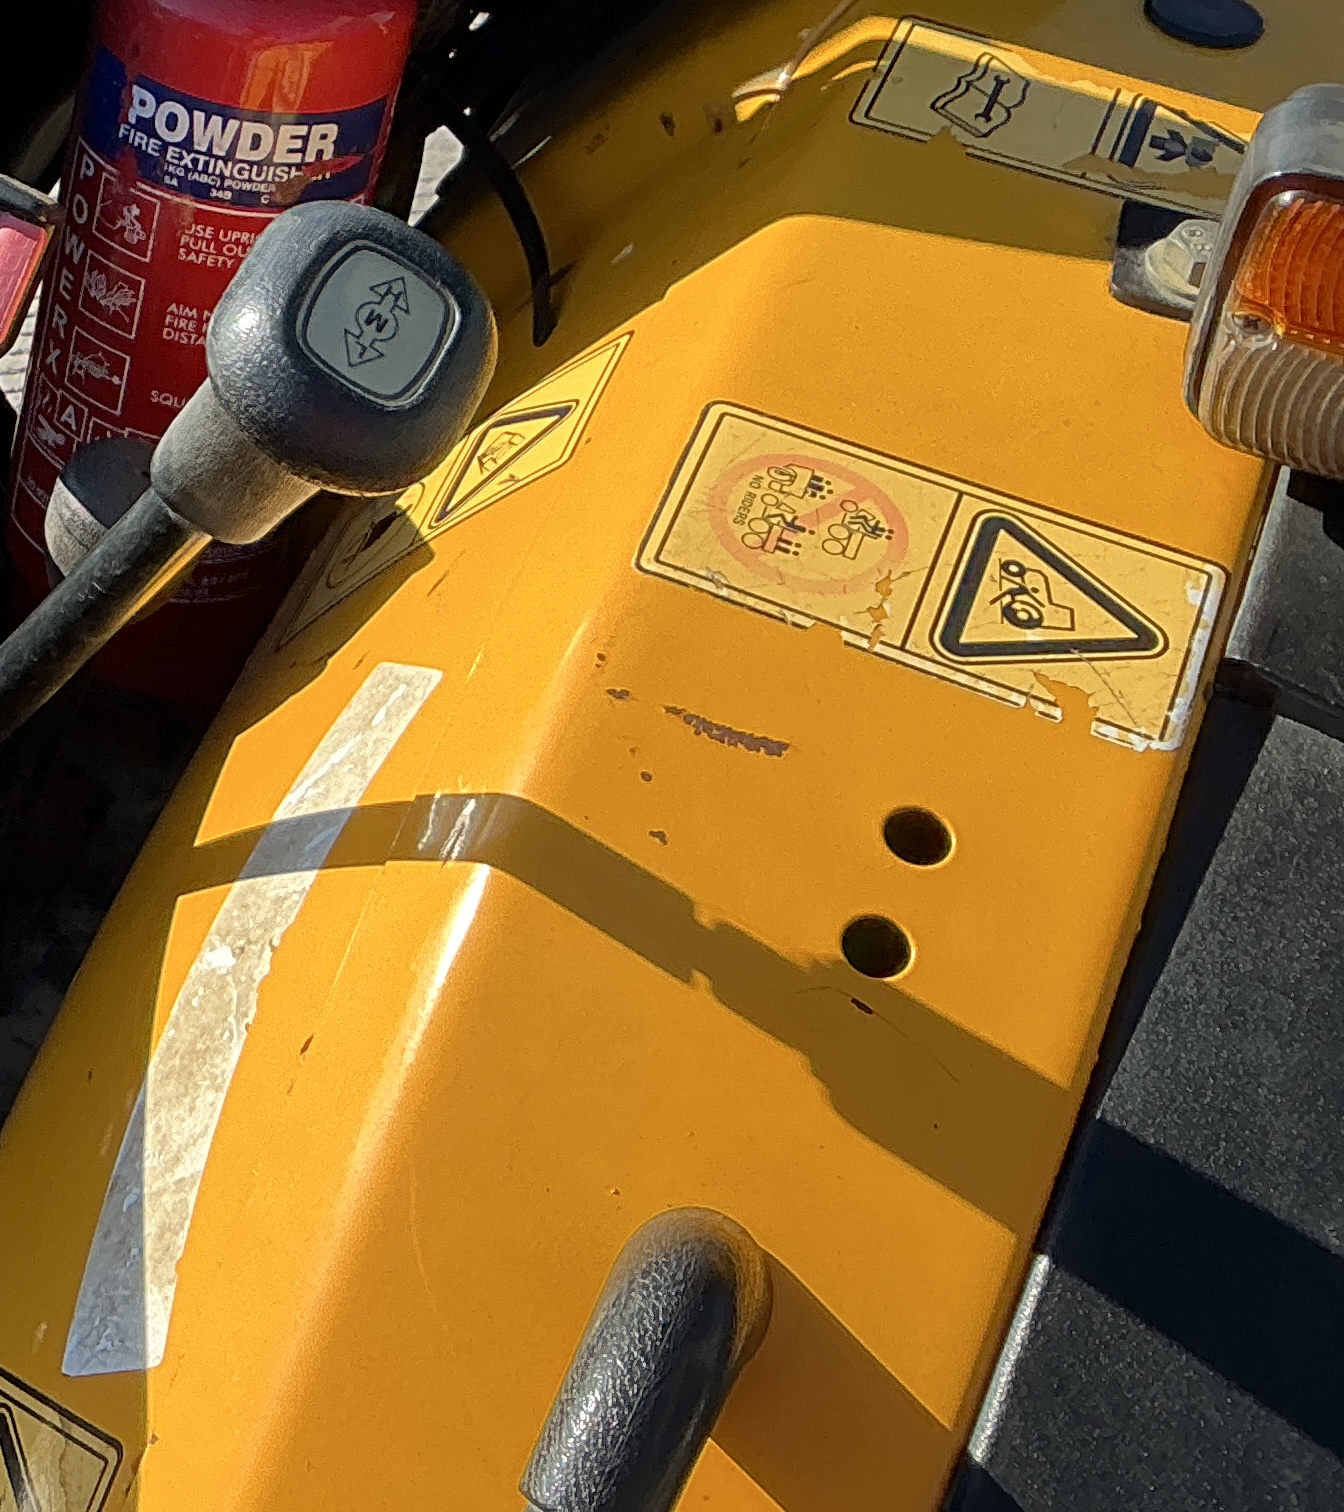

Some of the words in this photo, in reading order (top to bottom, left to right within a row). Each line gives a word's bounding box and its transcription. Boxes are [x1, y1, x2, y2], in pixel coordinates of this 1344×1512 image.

[128, 84, 339, 163] POWDER
[118, 122, 162, 156] FIRE
[187, 170, 221, 187] (ABC)
[223, 178, 277, 193] POWDER
[260, 194, 270, 205] C
[180, 235, 217, 255] PULL
[178, 248, 236, 269] SAFETY
[166, 302, 199, 319] AIM
[165, 314, 198, 332] FIRE
[61, 405, 76, 431] A
[749, 474, 764, 489] NO
[732, 490, 758, 526] RIDERS
